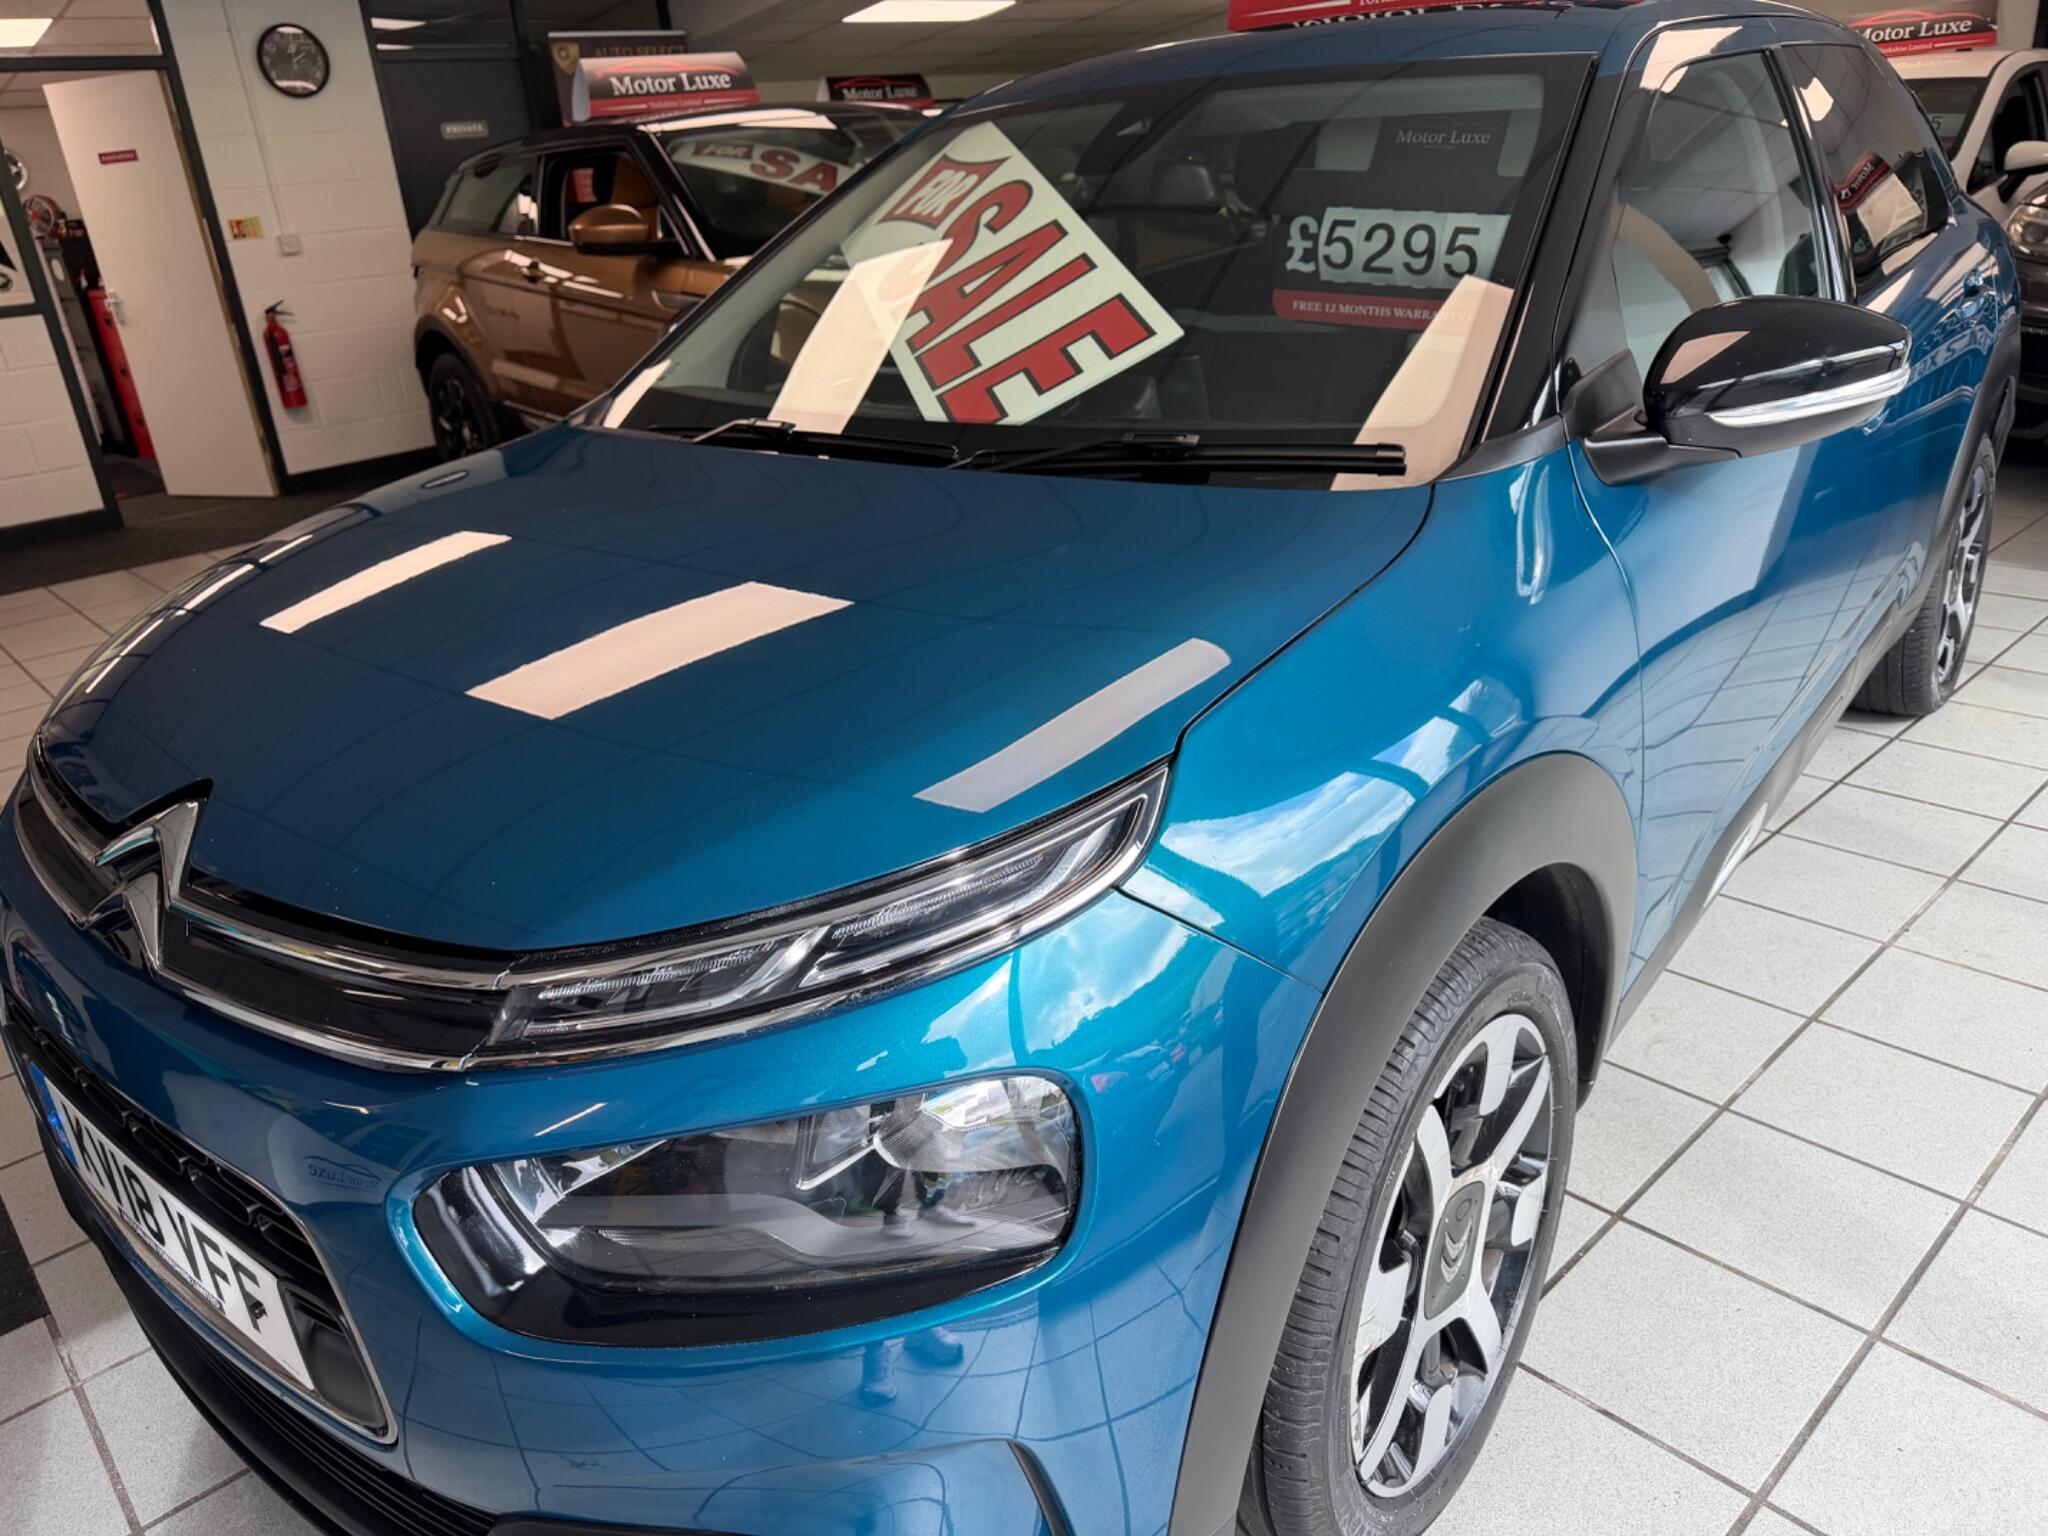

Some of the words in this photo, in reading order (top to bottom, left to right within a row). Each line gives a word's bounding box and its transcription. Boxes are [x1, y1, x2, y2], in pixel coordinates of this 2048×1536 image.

[1858, 26, 1914, 43] Motor
[1919, 18, 1972, 37] Luxe
[609, 75, 676, 96] Motor
[678, 72, 732, 92] Luxe
[1396, 129, 1447, 144] Motor
[1449, 129, 1491, 144] Luxe
[893, 169, 979, 217] FOR
[1286, 216, 1481, 278] £5295
[878, 179, 1157, 423] SALE
[1292, 300, 1323, 312] FREE
[1325, 302, 1337, 313] 12
[1338, 303, 1391, 318] MONTHS
[62, 1102, 166, 1247] KV18
[160, 1195, 261, 1333] VFF
